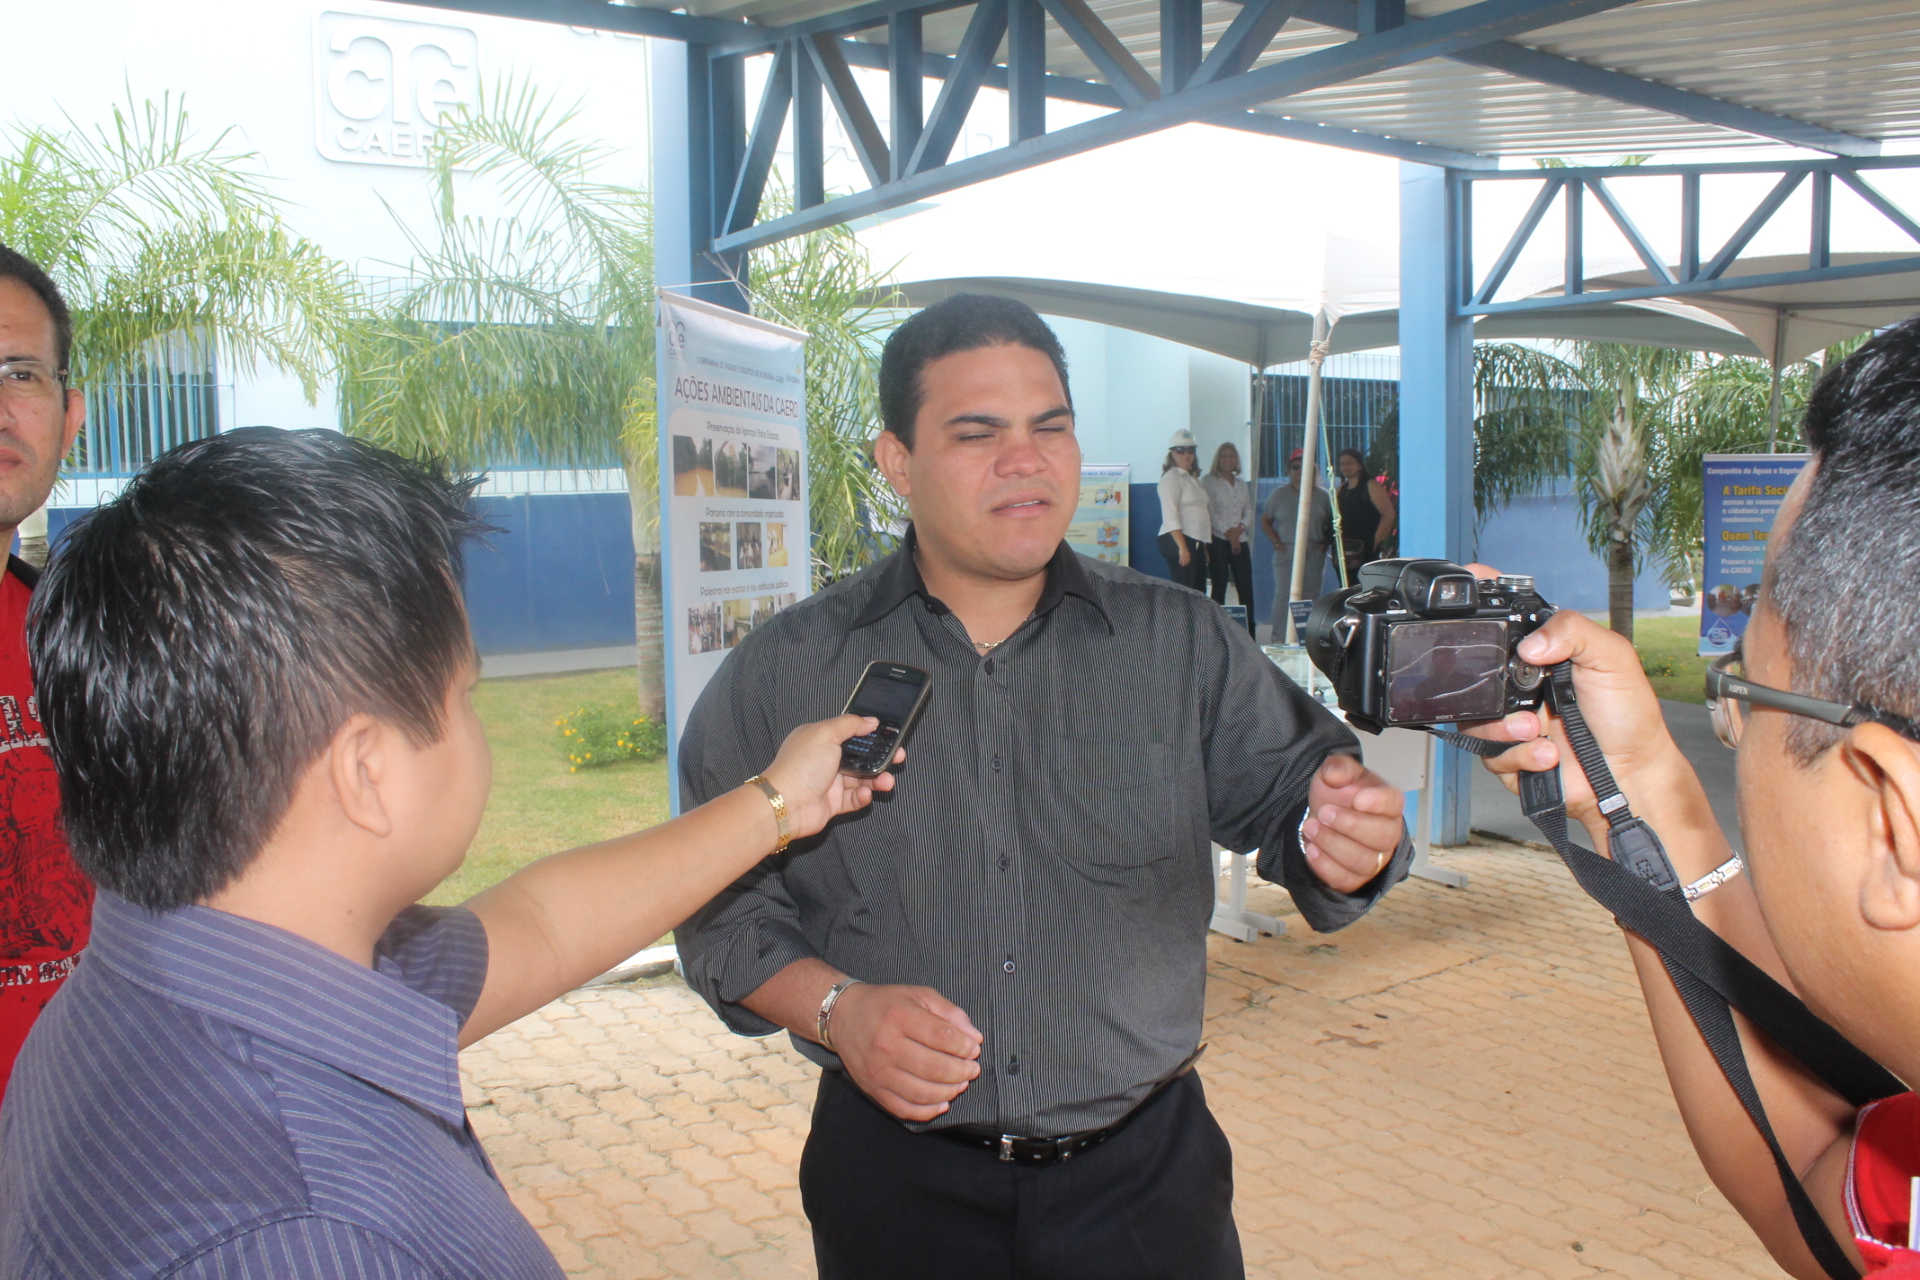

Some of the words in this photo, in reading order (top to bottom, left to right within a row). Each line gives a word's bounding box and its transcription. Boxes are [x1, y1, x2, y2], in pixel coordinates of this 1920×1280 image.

[674, 375, 709, 404] AÇÕES
[712, 384, 762, 411] AMBIENTAIS
[764, 394, 774, 414] DA
[776, 398, 798, 418] CAERD
[1753, 466, 1772, 476] Águas
[1723, 486, 1730, 496] A
[1733, 485, 1762, 496] Tarifa
[1722, 530, 1750, 541] Quem
[1728, 684, 1749, 695] ASPEN
